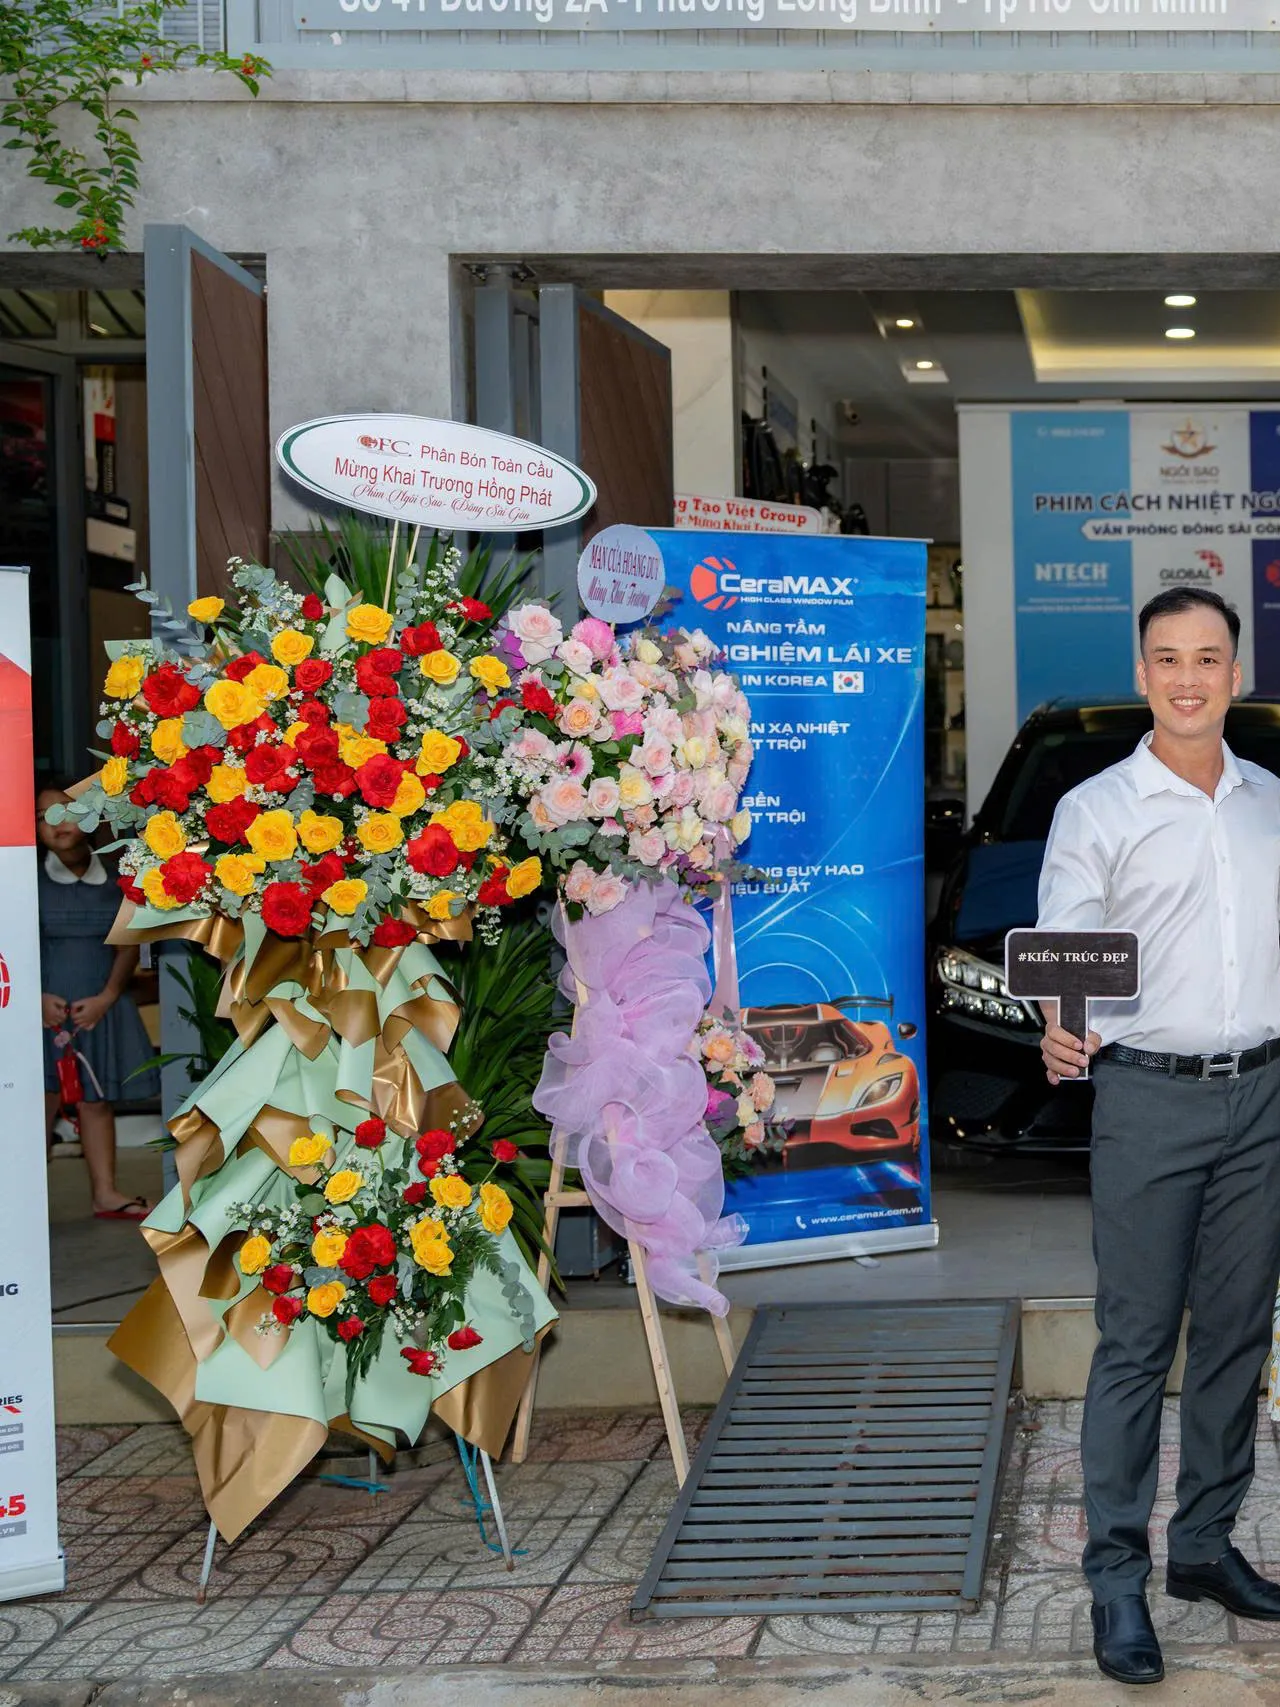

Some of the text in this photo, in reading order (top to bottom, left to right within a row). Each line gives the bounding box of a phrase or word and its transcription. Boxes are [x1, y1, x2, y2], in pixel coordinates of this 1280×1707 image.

[421, 445, 456, 464] Phân
[460, 452, 487, 469] Bón
[491, 456, 522, 474] Toàn
[527, 460, 554, 478] Cầu
[335, 457, 553, 507] Mừng Khai Trương Hồng Phát
[1035, 494, 1093, 511] PHIM
[1100, 489, 1161, 511] CÁCH
[1169, 490, 1235, 516] NHIỆT
[692, 498, 721, 515] Tạo
[726, 502, 755, 519] Việt
[760, 507, 807, 527] Group
[1035, 562, 1108, 581] NTECH
[1160, 568, 1212, 580] GLOBAL
[741, 596, 762, 604] HIGH
[793, 597, 832, 605] WINDOW
[727, 617, 825, 635] NÂNG TẦM
[828, 643, 870, 663] LÁI
[877, 647, 912, 664] XE
[742, 674, 828, 687] IN KOREA
[768, 722, 793, 736] XẠ
[797, 720, 850, 737] NHIỆT
[766, 736, 806, 752] TRỘI
[765, 809, 806, 825] TRỘI
[786, 865, 821, 877] SUY
[825, 864, 865, 876] HAO
[1018, 949, 1129, 964] #KIẾN TRÚC ĐẸP
[811, 1206, 923, 1225] www.ceramax.com.vn
